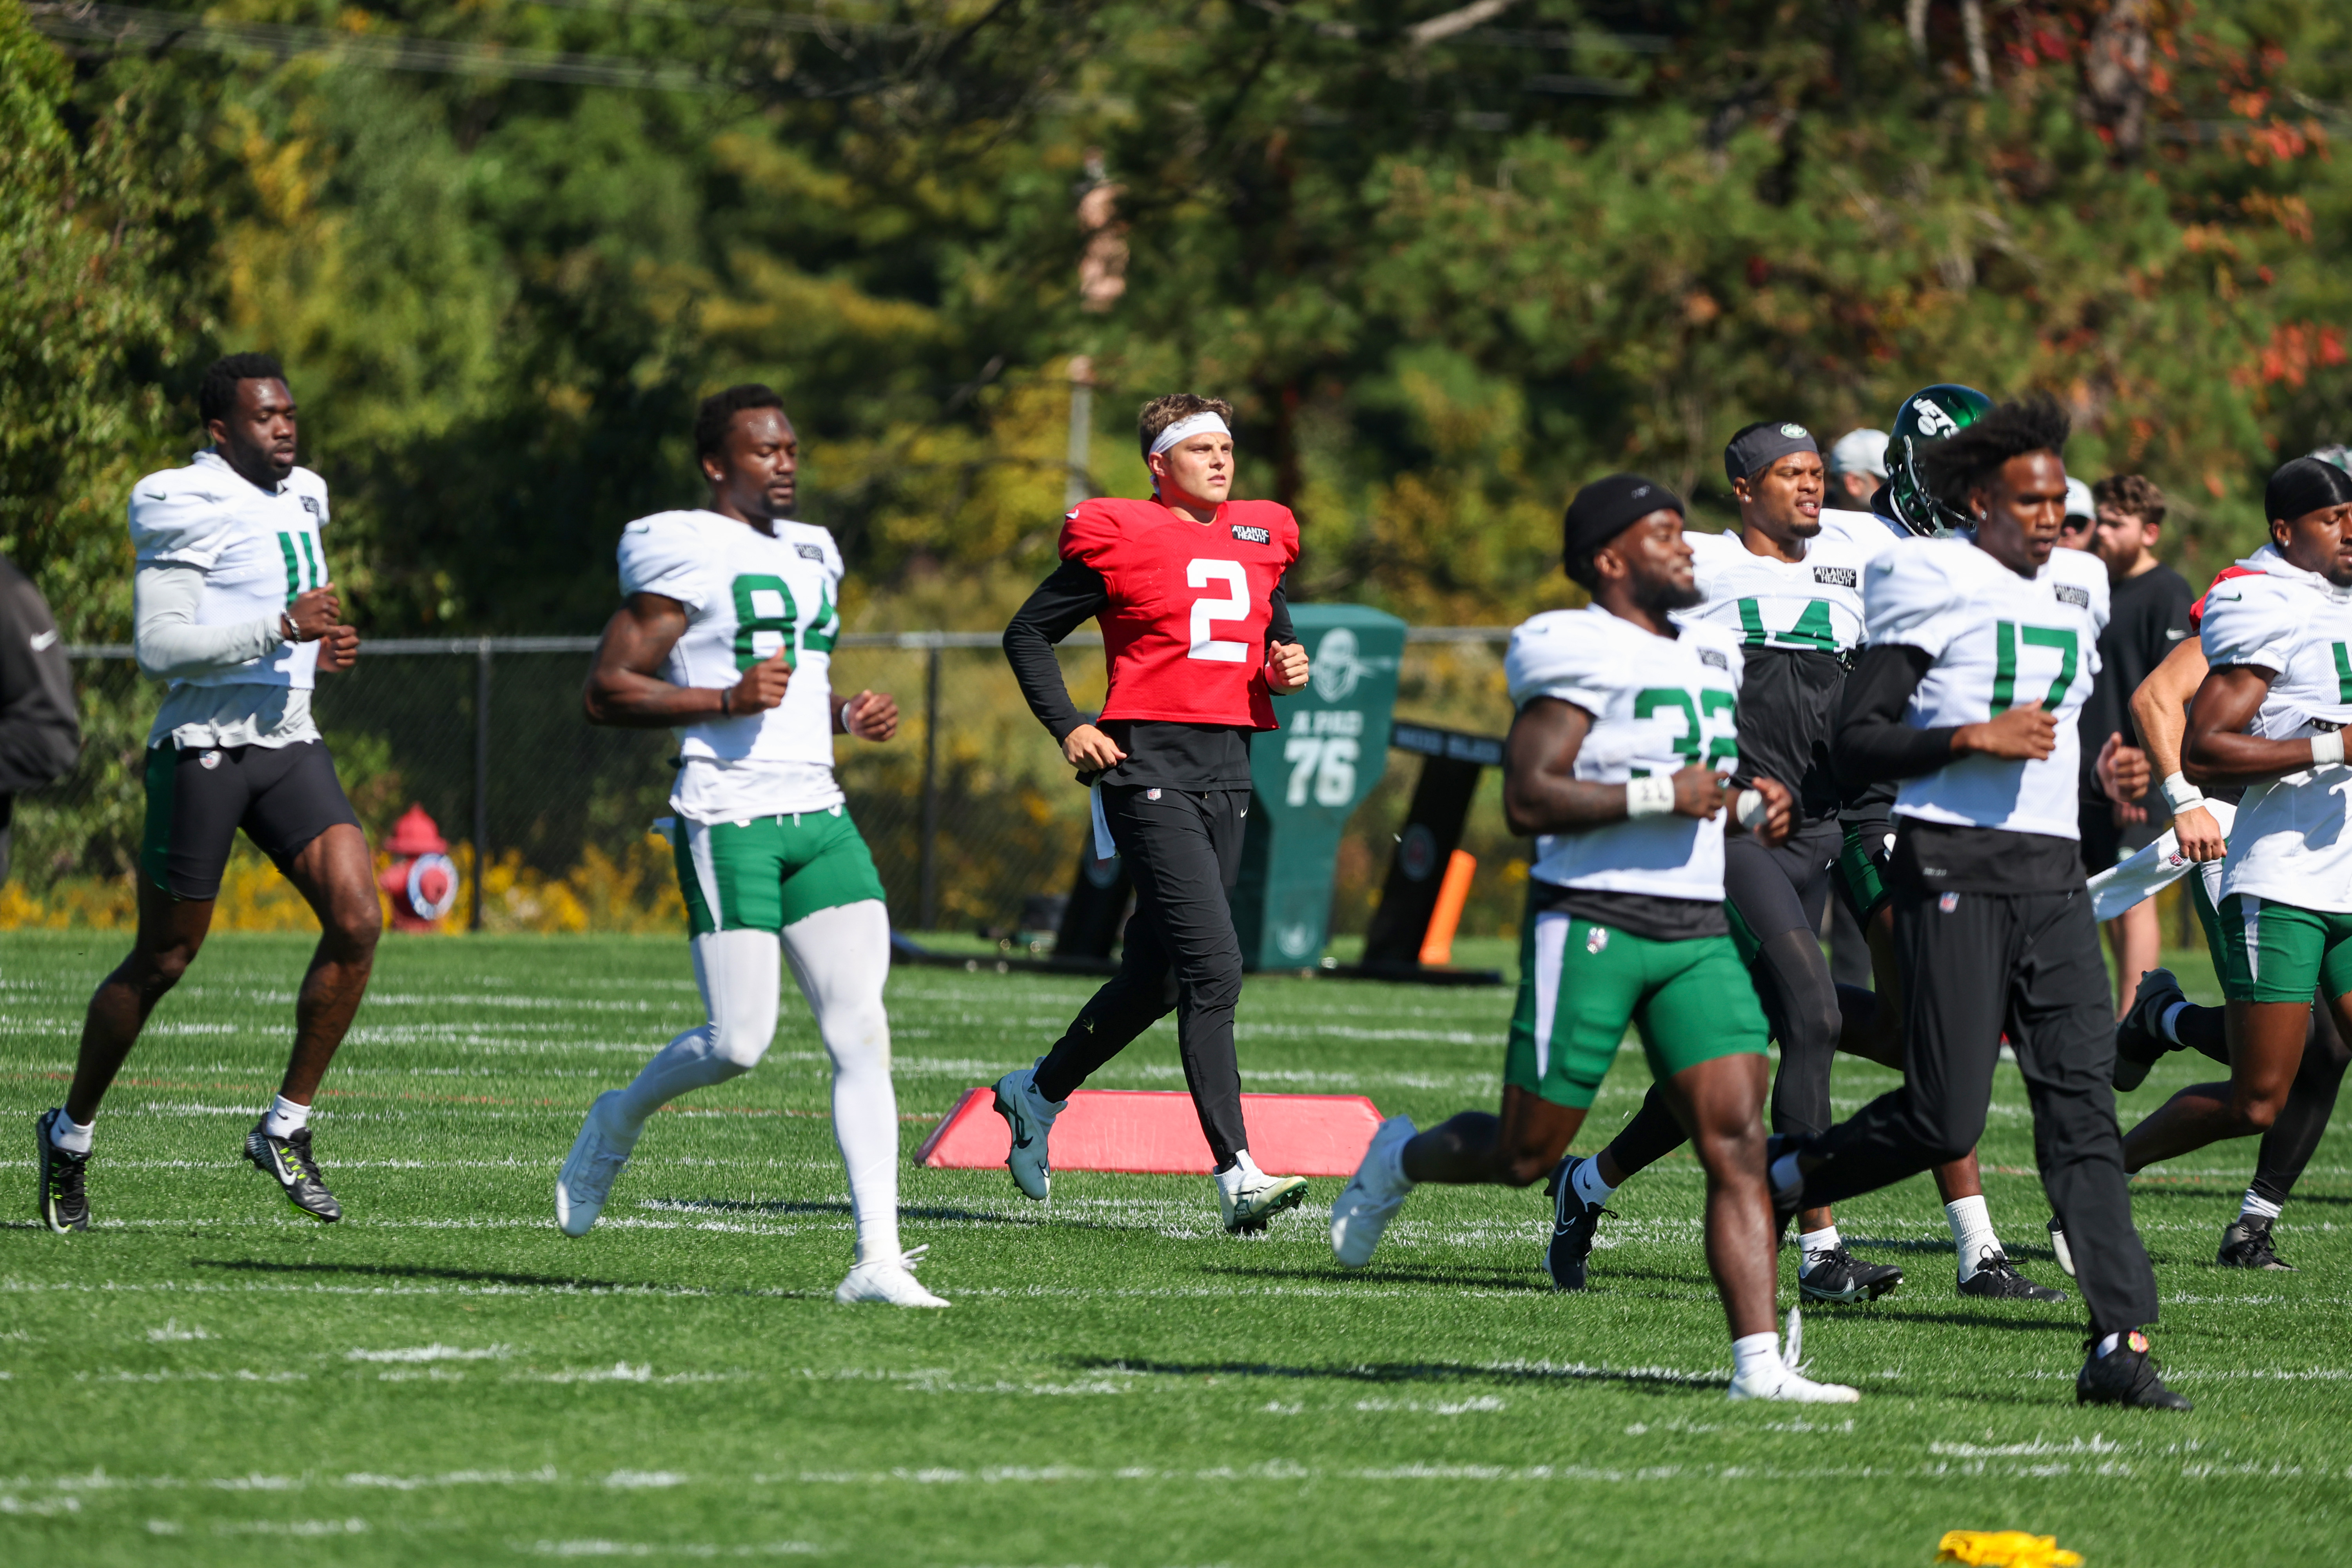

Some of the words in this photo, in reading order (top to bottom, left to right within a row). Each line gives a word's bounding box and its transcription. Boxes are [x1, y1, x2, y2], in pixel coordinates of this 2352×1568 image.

[1232, 525, 1269, 537] ATLANTIC
[1237, 531, 1265, 544] HEALTH
[277, 531, 317, 609] 11
[1815, 566, 1855, 579] ATLANTIC
[1821, 573, 1851, 586] HEALTH
[732, 573, 840, 675] 84
[1186, 558, 1250, 662] 2
[1737, 598, 1839, 651] 14
[1989, 620, 2078, 720] 17
[1284, 736, 1361, 807] 76
[2169, 853, 2183, 866] NFL
